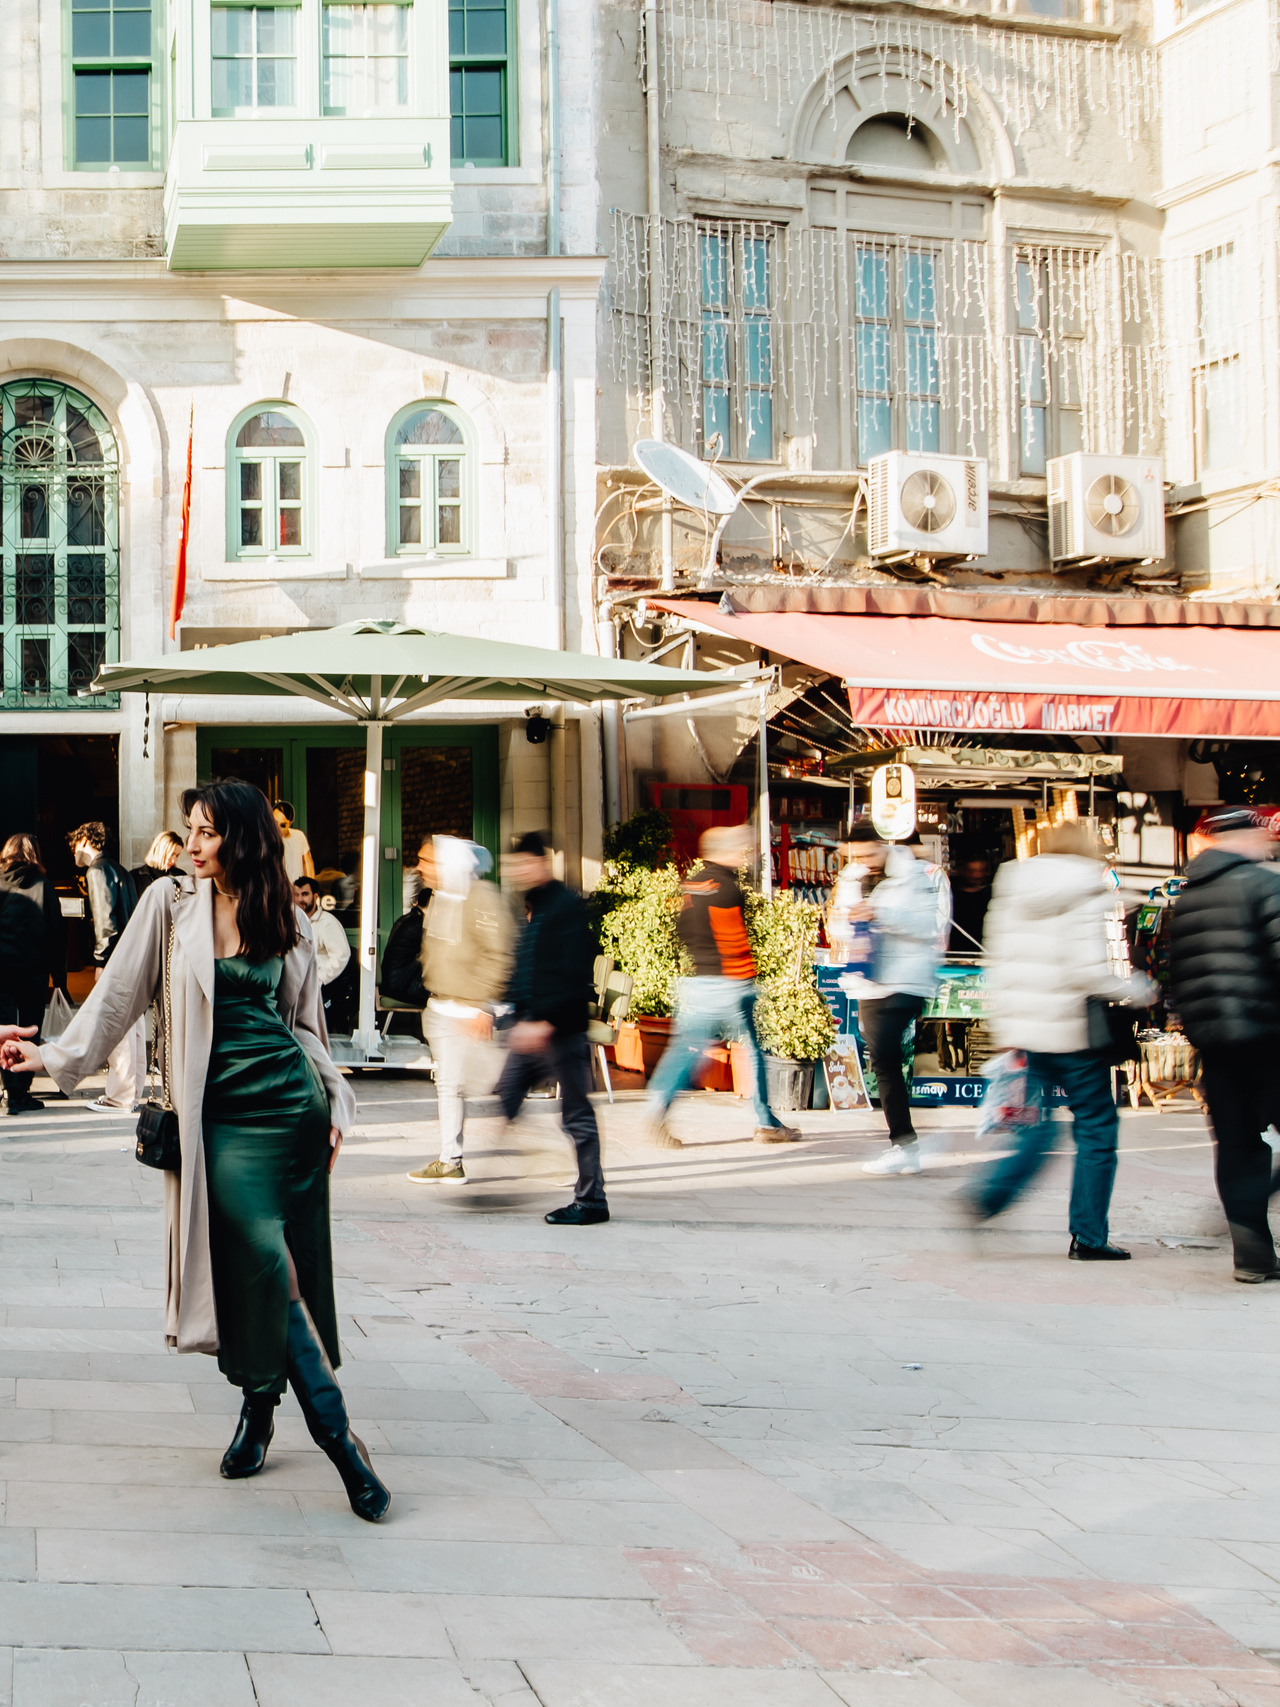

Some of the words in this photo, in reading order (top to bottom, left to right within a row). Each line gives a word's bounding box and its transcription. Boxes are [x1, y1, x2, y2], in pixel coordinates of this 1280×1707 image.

[965, 463, 978, 512] arçelik
[884, 693, 1026, 729] KÖMÜRCÜOĞLU
[1041, 703, 1115, 732] MARKET
[828, 1060, 847, 1075] Salep
[954, 1083, 984, 1098] ICE
